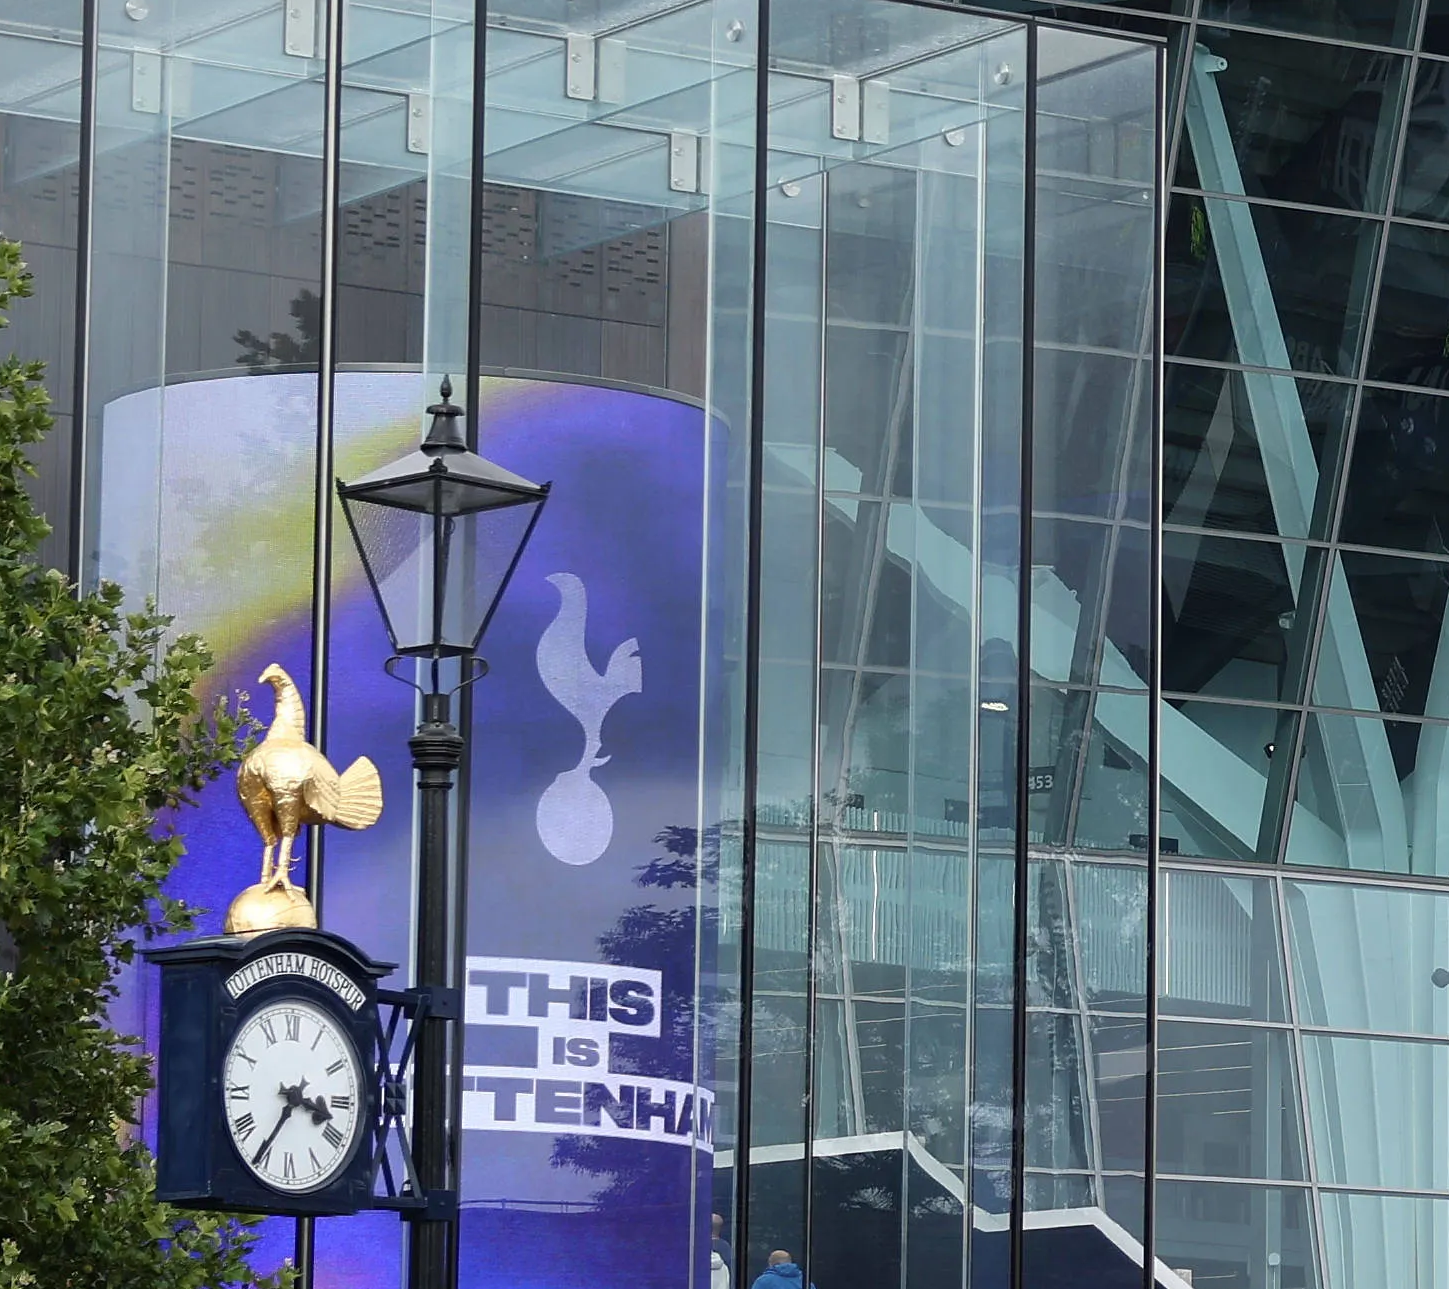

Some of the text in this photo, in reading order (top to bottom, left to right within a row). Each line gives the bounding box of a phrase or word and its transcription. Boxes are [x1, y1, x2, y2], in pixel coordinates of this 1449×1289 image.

[227, 955, 363, 1010] TOTTENHAM HOTSPUR
[469, 969, 655, 1027] THIS
[285, 1014, 301, 1042] XII
[552, 1036, 600, 1068] IS
[331, 1095, 350, 1110] III
